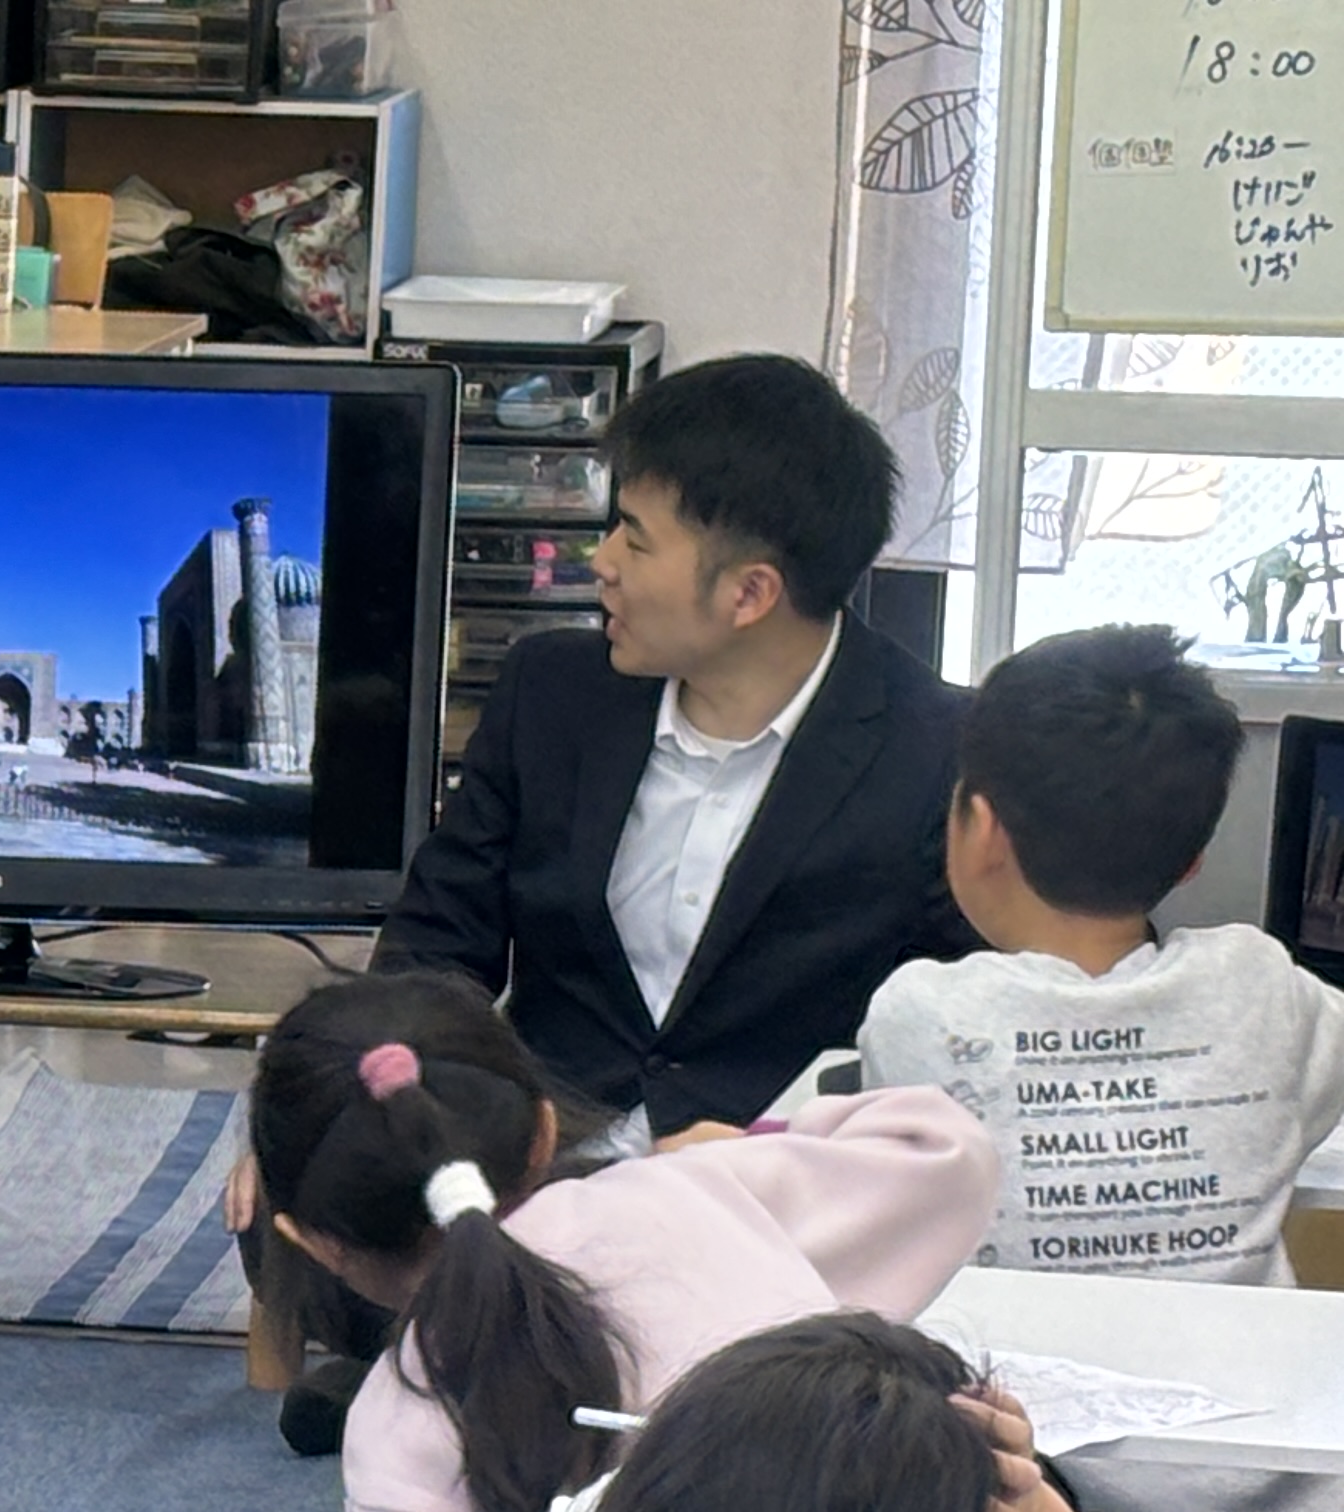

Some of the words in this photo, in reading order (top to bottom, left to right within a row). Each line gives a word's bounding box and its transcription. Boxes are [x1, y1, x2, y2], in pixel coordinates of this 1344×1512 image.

[1176, 34, 1316, 86] 18:00
[1015, 1030, 1063, 1053] BIG
[1071, 1027, 1145, 1051] LIGHT
[1021, 1132, 1110, 1156] SMALL
[1116, 1125, 1189, 1151] LIGHT
[1025, 1184, 1087, 1208] TIME
[1095, 1174, 1221, 1206] MACHINE
[1030, 1232, 1161, 1259] TORINUKE
[1168, 1224, 1239, 1251] HOOP
